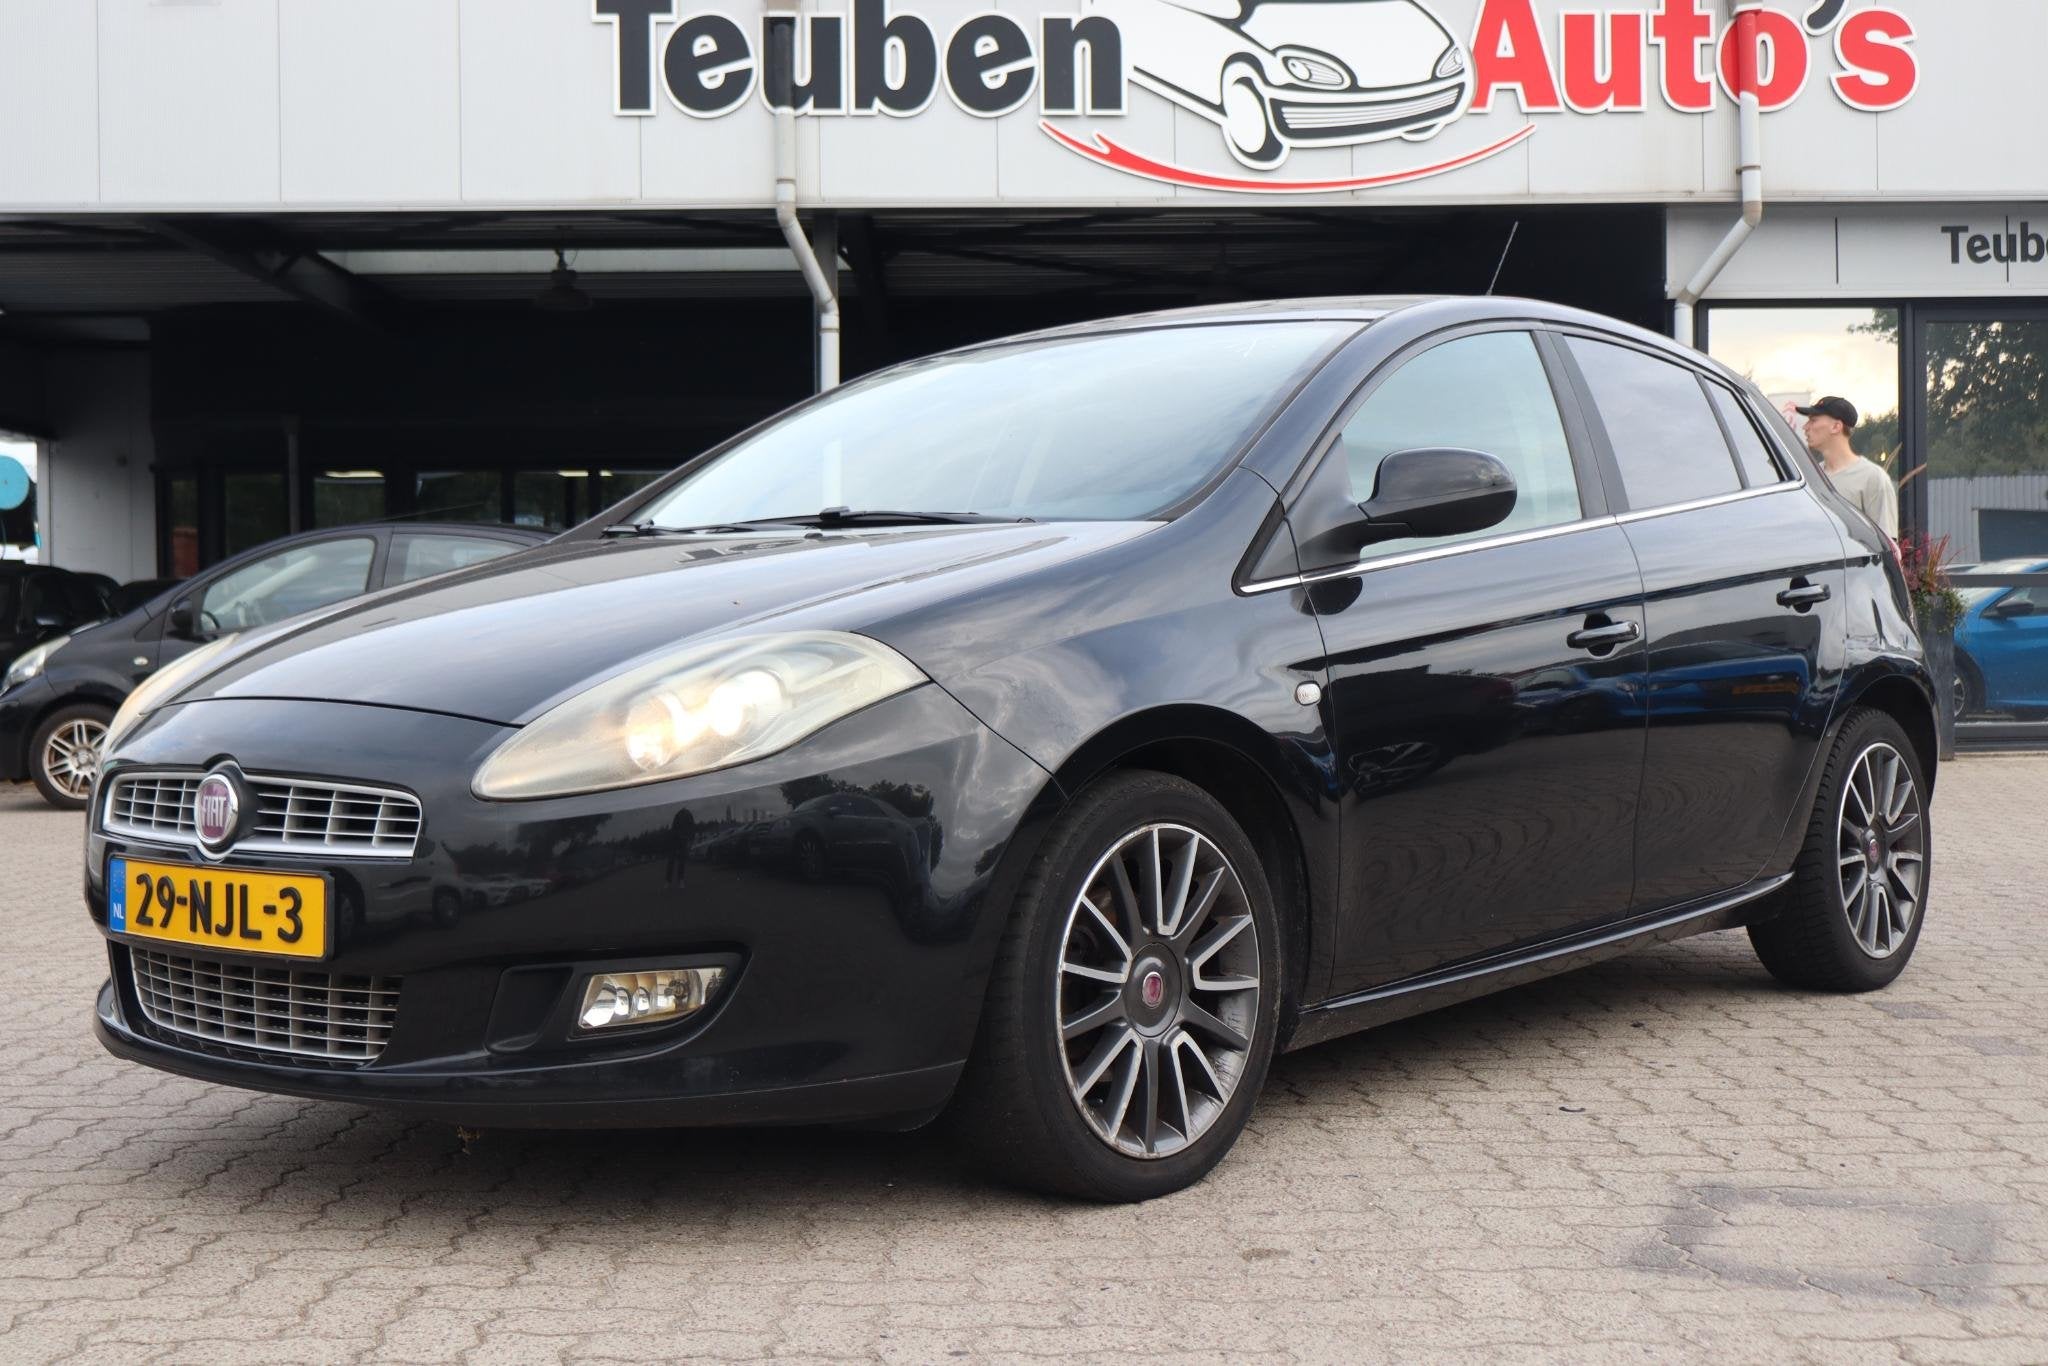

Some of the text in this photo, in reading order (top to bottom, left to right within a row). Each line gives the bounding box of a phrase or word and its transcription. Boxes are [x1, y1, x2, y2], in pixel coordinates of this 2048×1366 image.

[595, 0, 1917, 113] Teuben Auto's
[1940, 221, 2048, 264] Teub
[201, 795, 227, 827] FIAT
[112, 902, 125, 920] NL
[134, 872, 304, 944] 29-NJL-3
